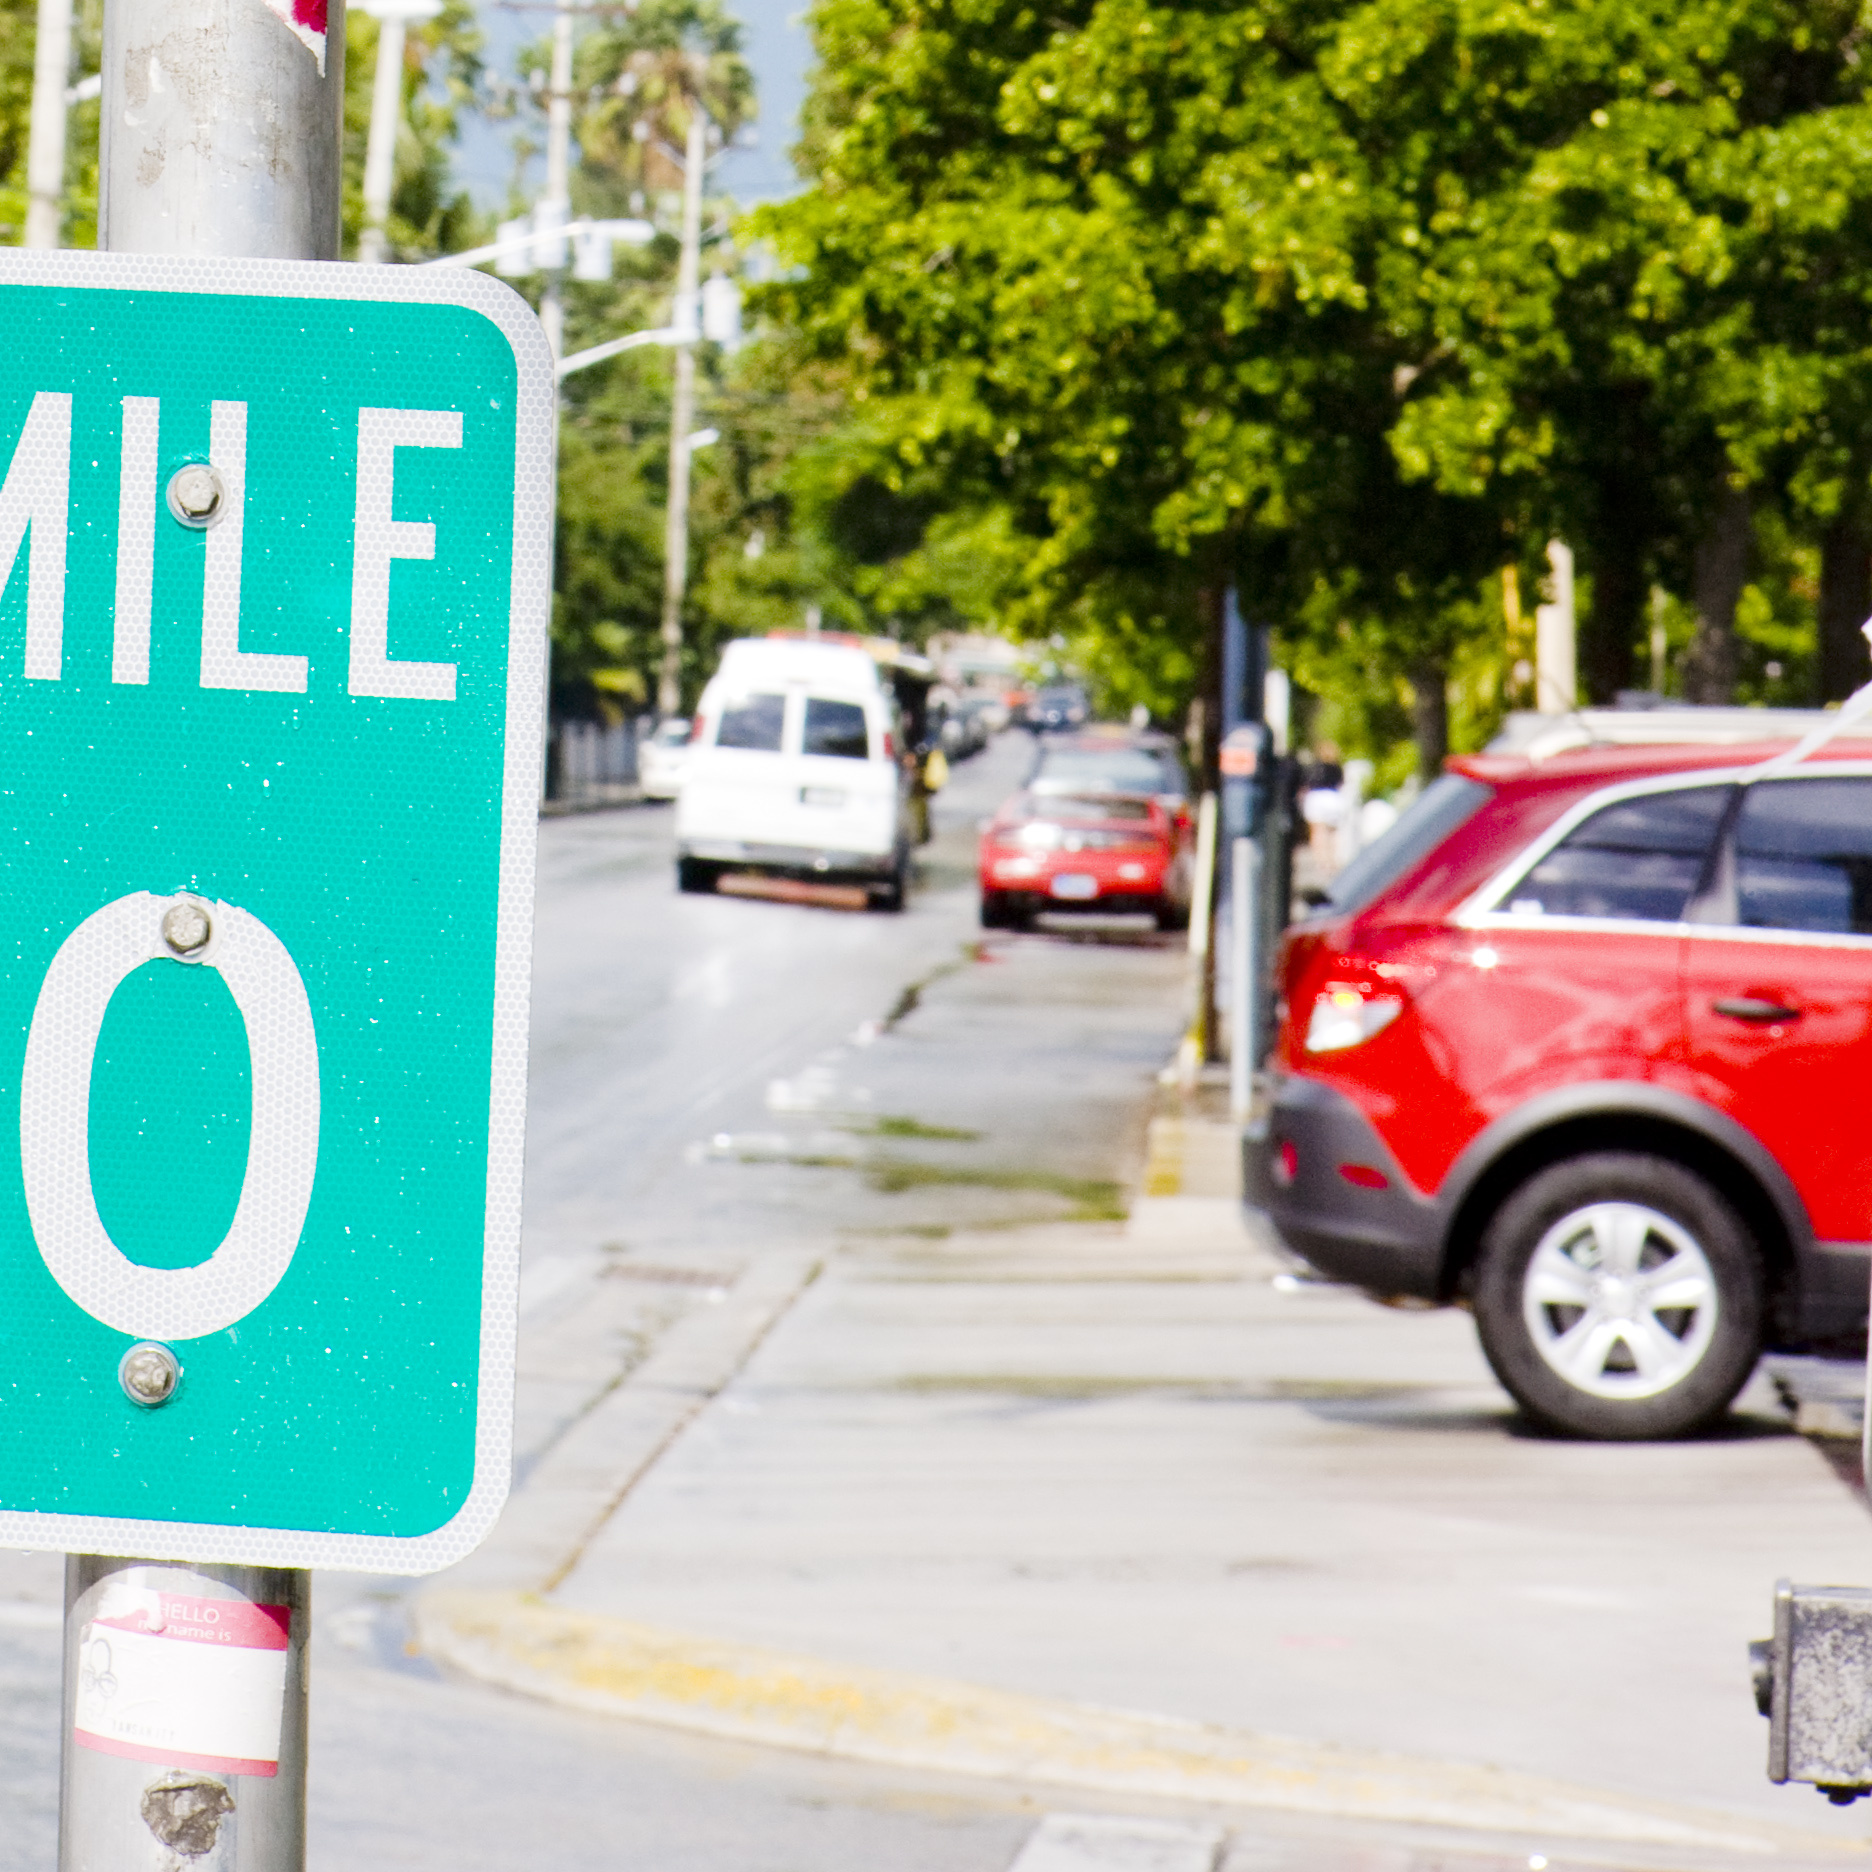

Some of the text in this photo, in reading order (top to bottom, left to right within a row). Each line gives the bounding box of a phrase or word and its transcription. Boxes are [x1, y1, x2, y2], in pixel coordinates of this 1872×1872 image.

[20, 889, 321, 1341] 0
[160, 1602, 220, 1624] HELLO
[167, 1624, 215, 1640] name
[218, 1627, 232, 1642] is
